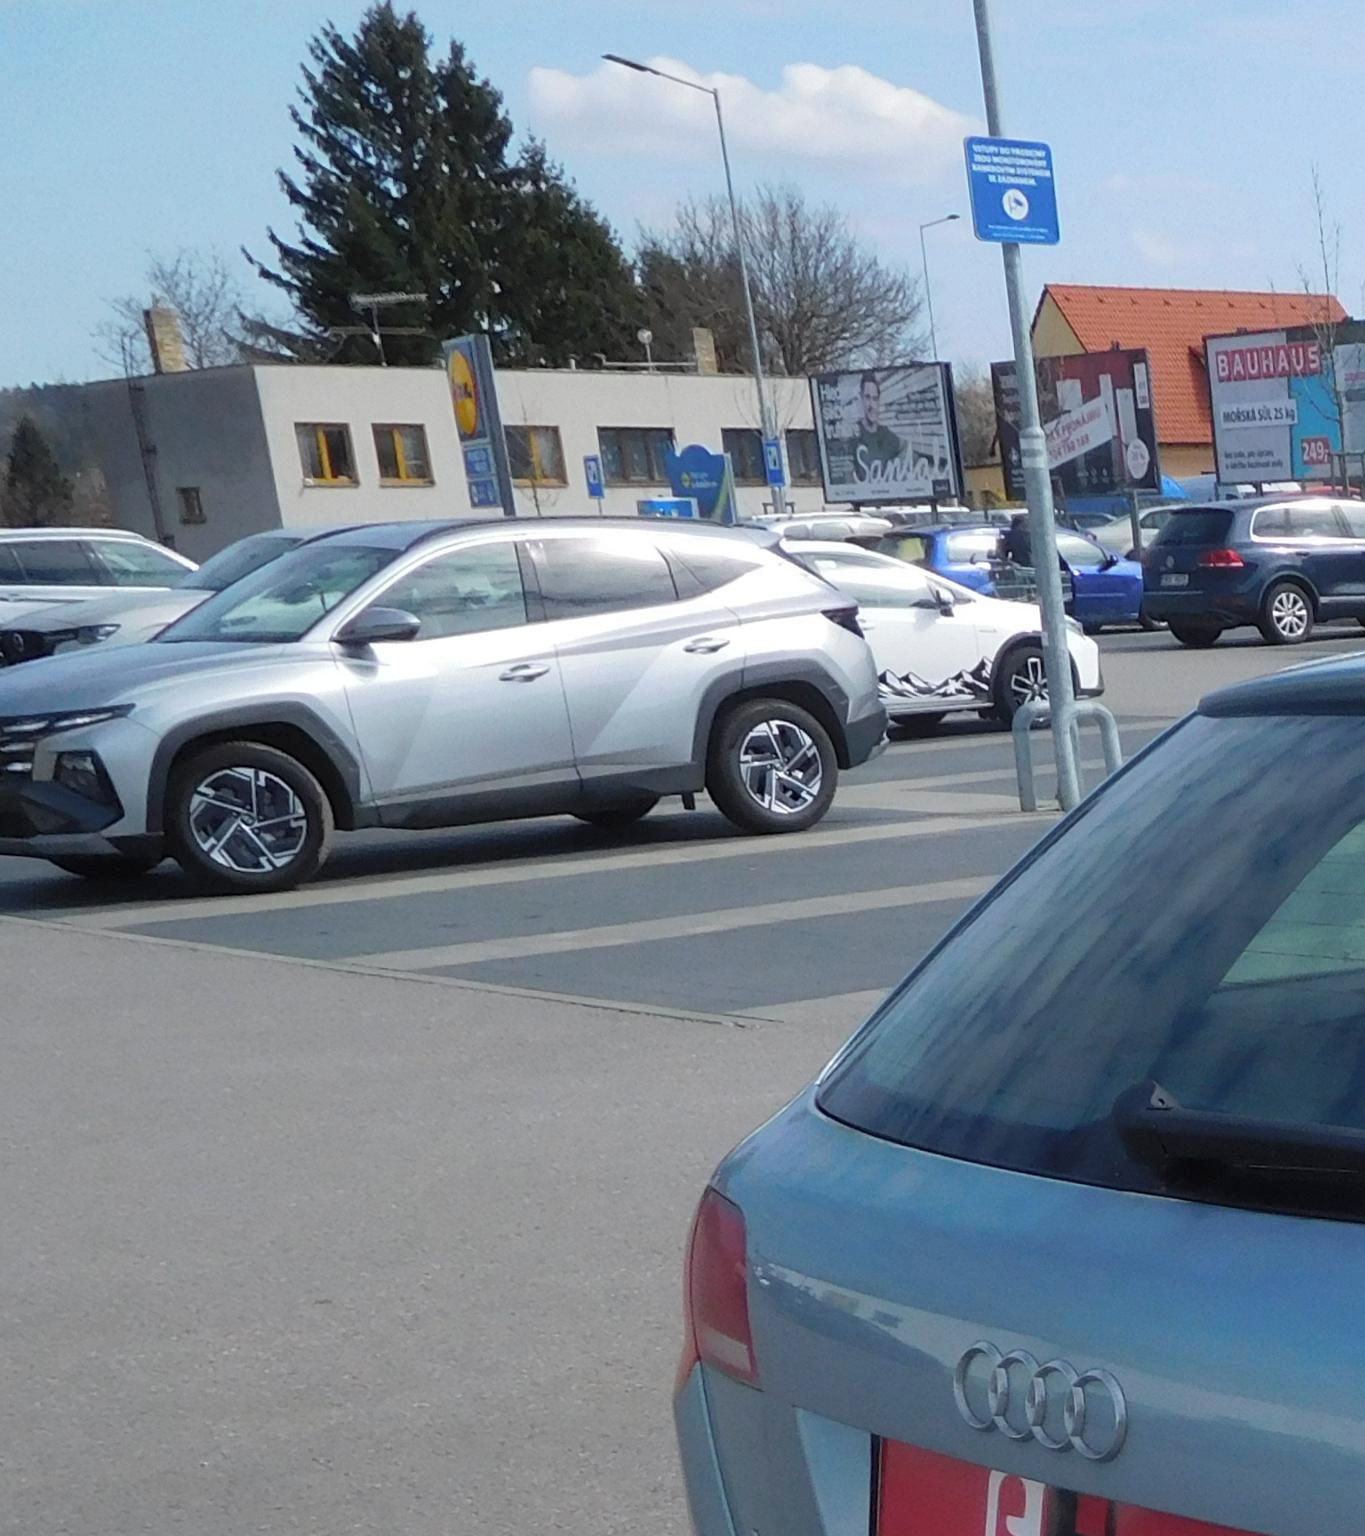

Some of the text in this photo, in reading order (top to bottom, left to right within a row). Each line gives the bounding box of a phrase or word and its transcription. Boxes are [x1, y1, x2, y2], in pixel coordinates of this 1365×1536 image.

[1217, 346, 1321, 378] BAUHAUS
[1222, 405, 1296, 424] MOŘSKÁ SŮL 25 kg
